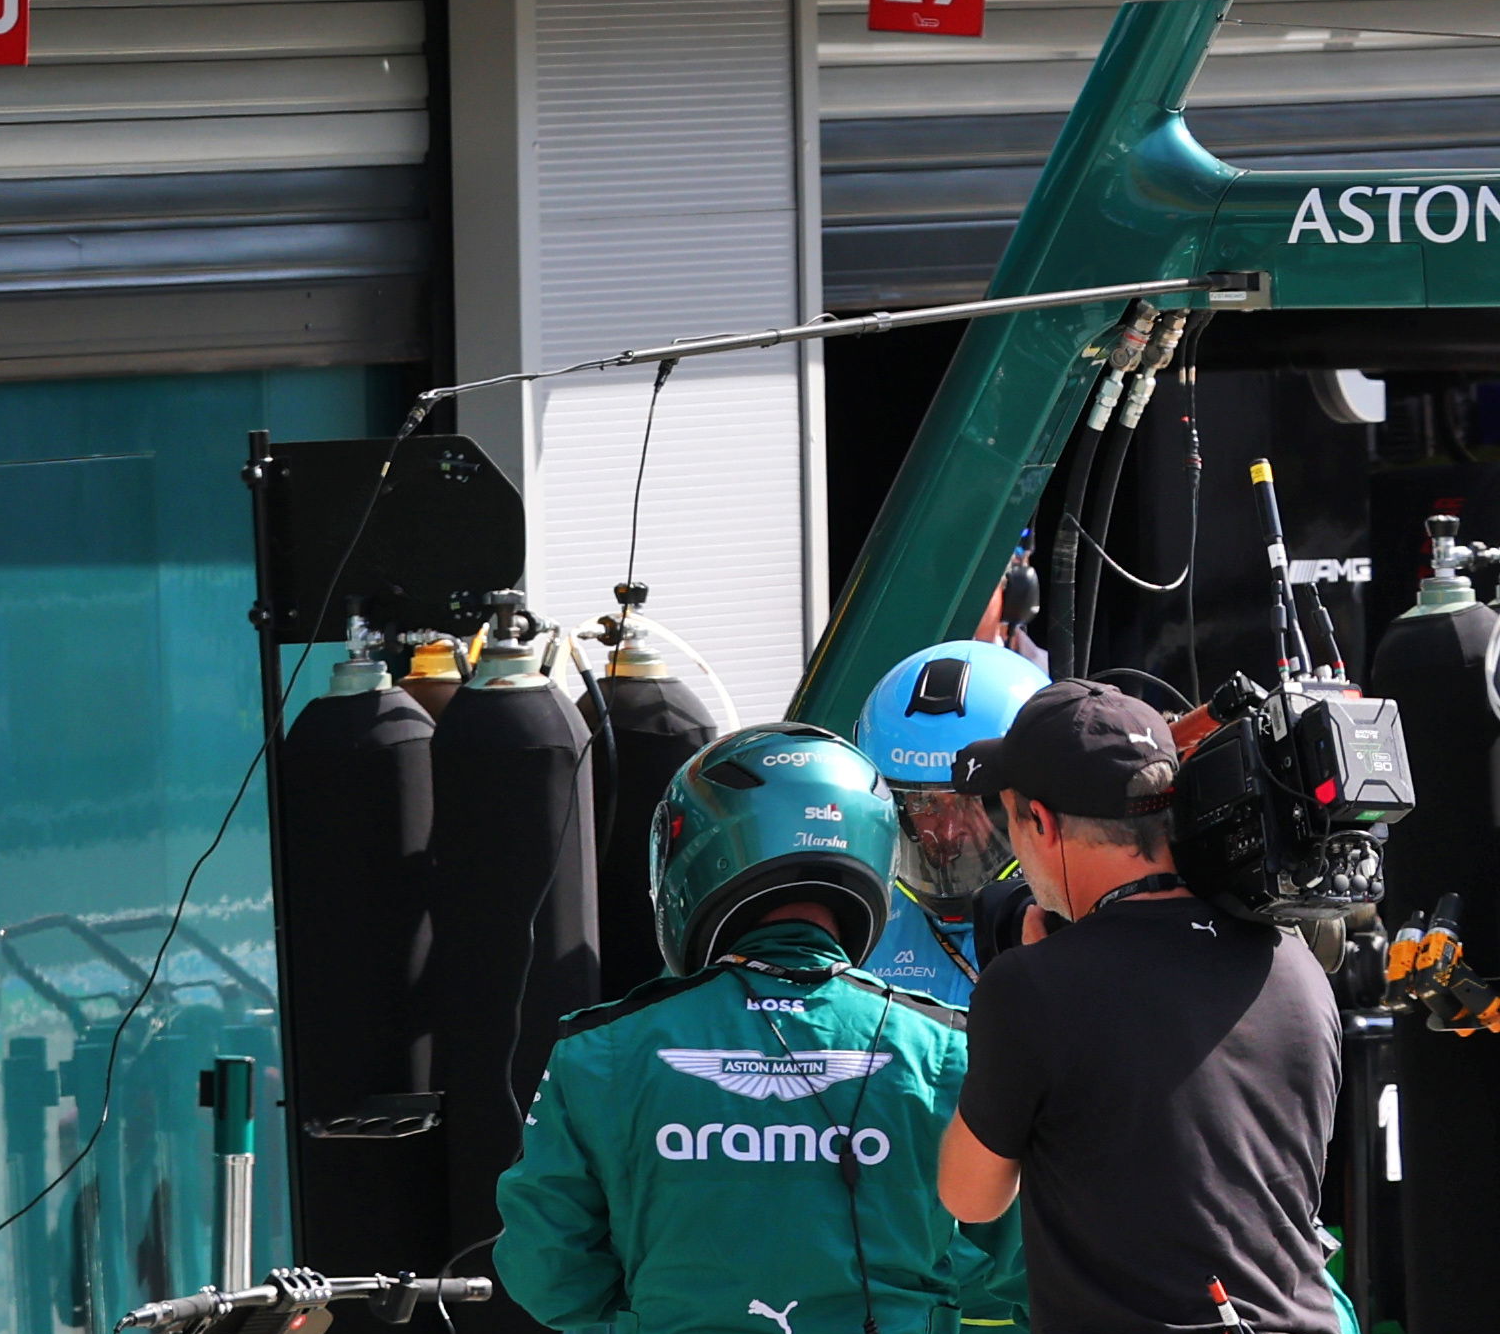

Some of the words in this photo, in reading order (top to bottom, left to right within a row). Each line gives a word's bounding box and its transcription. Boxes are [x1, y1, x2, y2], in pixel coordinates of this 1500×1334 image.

[890, 747, 957, 768] aram
[793, 832, 848, 850] Marsha
[871, 965, 936, 979] MAADEN
[746, 998, 805, 1013] BOSS
[723, 1058, 768, 1076] ASTON
[771, 1058, 825, 1076] MARTIN
[656, 1122, 891, 1167] aramco
